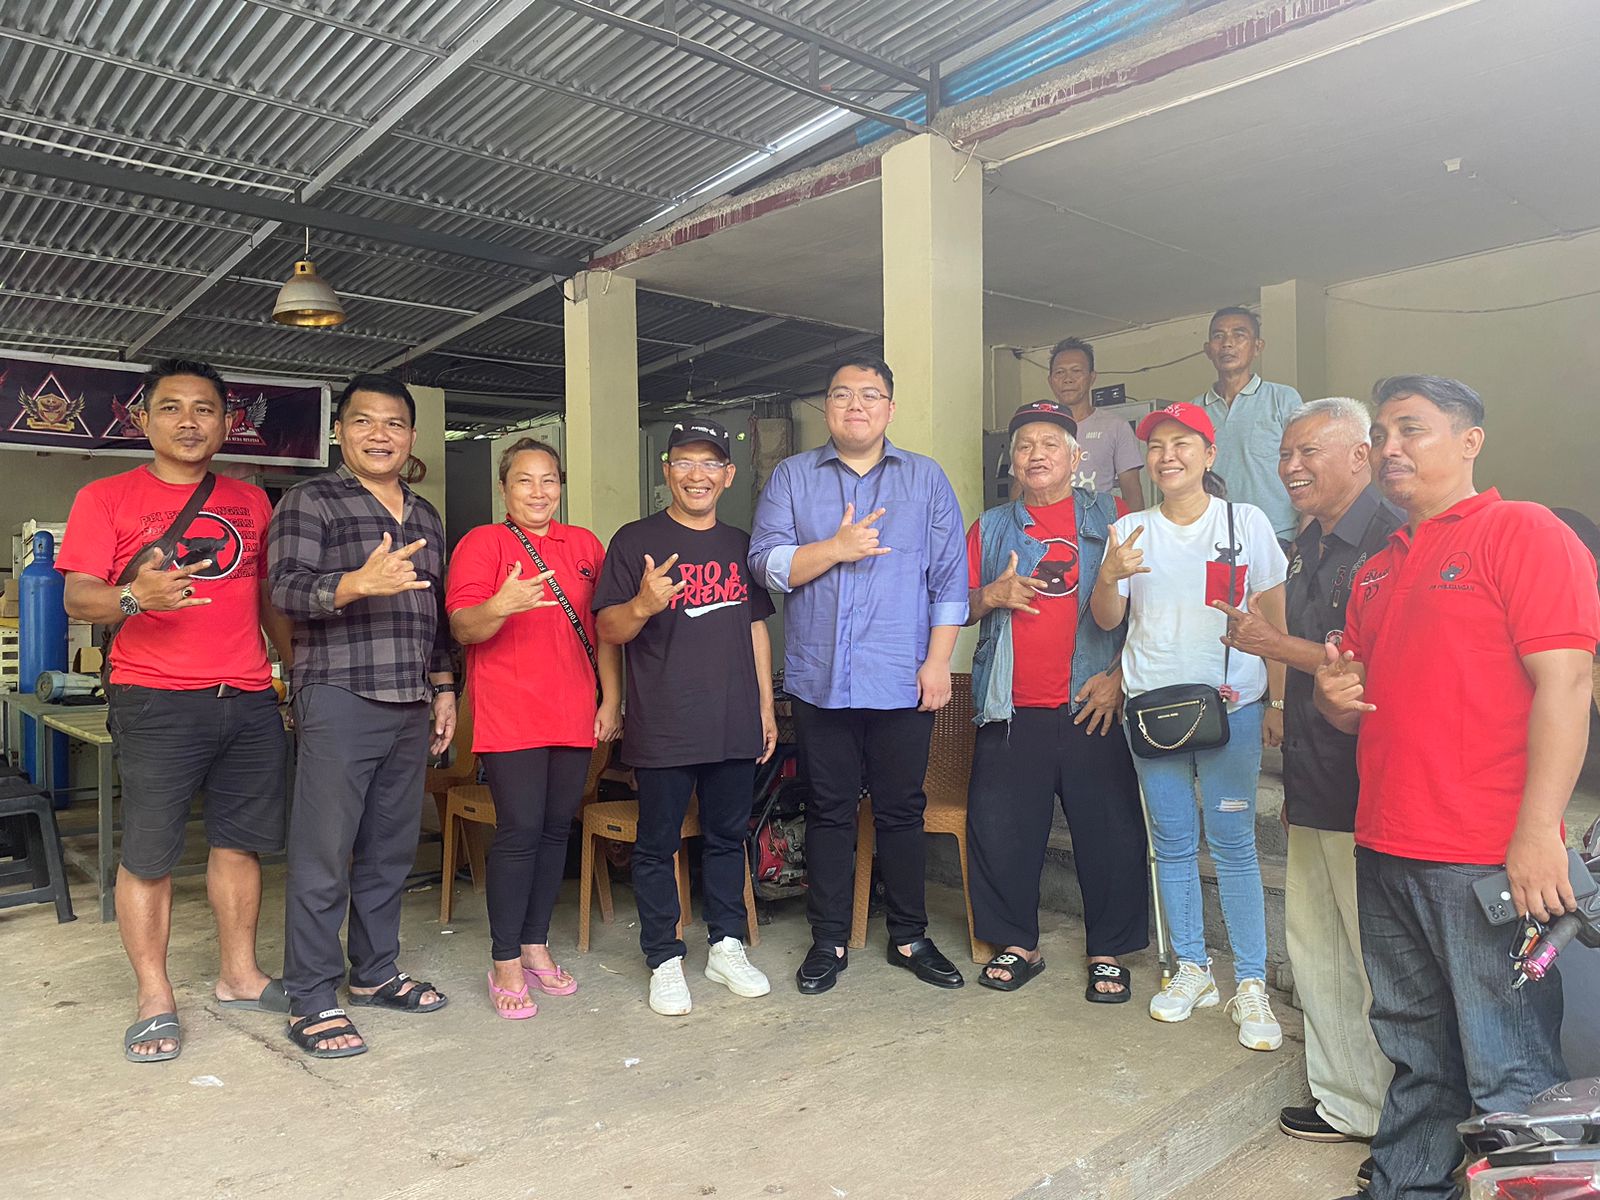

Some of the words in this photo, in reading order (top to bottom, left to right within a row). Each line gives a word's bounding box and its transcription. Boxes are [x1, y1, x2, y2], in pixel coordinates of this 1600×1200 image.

[525, 543, 547, 572] FOREVER
[546, 574, 562, 597] YOUN
[678, 560, 722, 588] RIO
[558, 595, 579, 624] FOREVER
